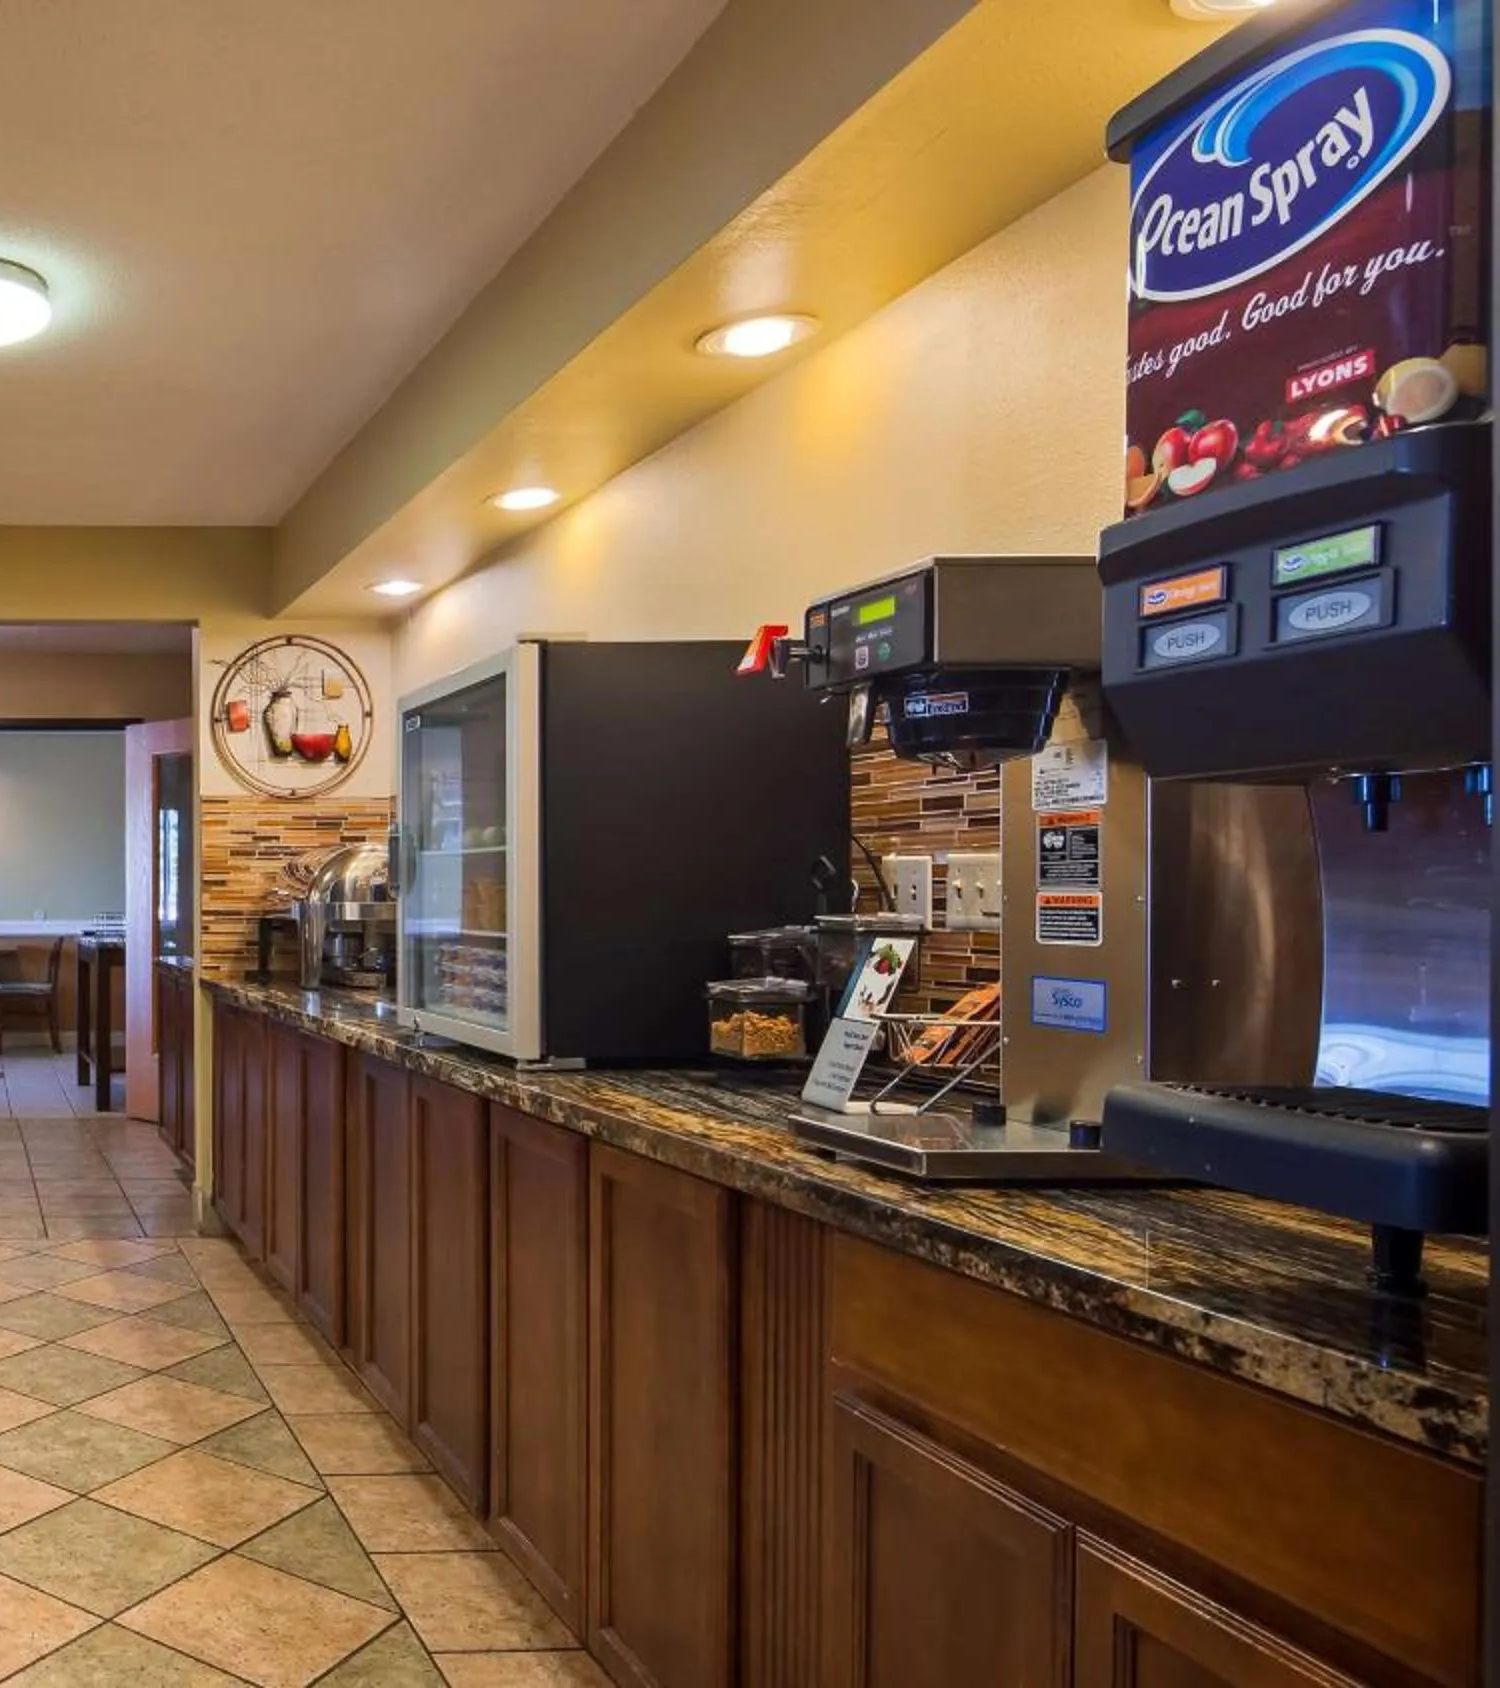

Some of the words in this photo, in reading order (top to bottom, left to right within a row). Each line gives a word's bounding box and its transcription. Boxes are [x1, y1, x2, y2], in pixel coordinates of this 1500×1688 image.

[1142, 191, 1245, 256] Ocean
[1249, 86, 1375, 227] Spray
[1165, 309, 1231, 378] good.
[1241, 271, 1313, 331] Good
[1312, 262, 1359, 308] for
[1360, 240, 1445, 296] you.
[1291, 355, 1368, 399] LYONS
[1305, 600, 1352, 623] PUSH
[1167, 632, 1205, 650] PUSH
